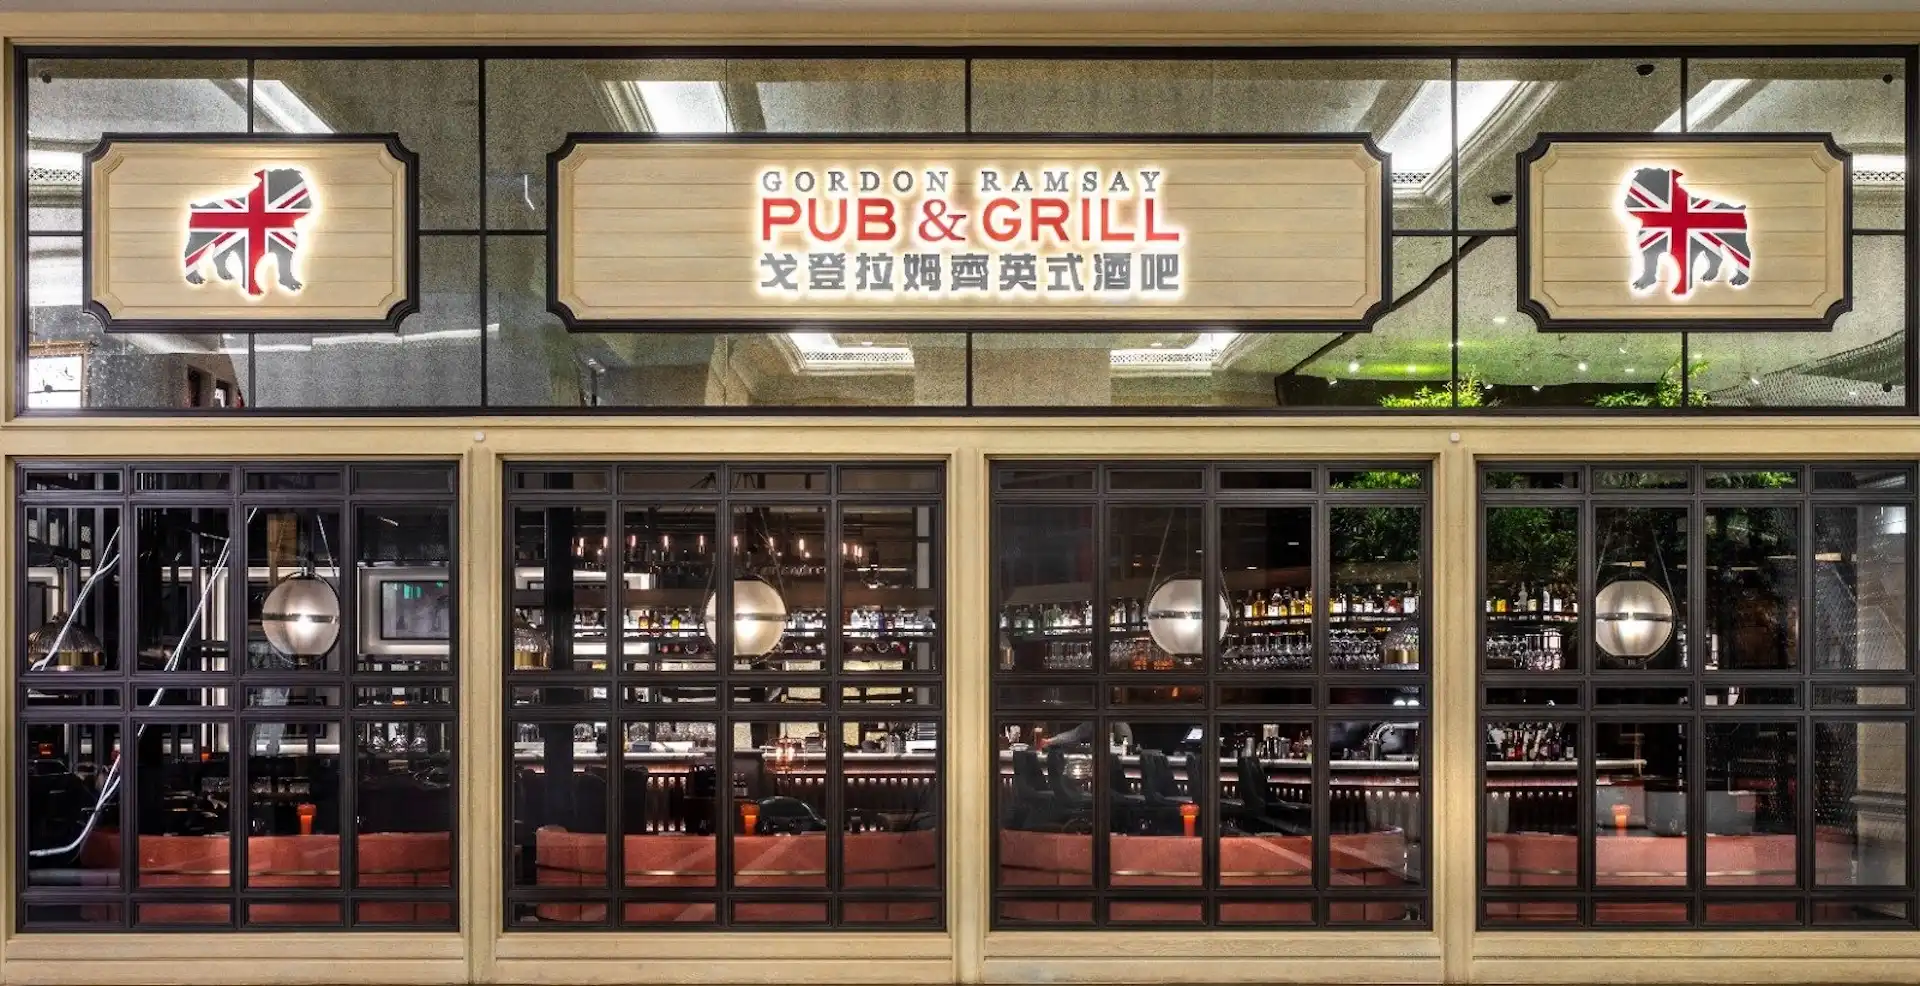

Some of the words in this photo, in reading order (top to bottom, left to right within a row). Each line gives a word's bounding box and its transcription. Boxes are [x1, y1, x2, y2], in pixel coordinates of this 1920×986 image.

[762, 171, 949, 192] GORDON
[981, 171, 1160, 192] RAMSAY
[762, 197, 896, 241] PUB
[918, 199, 967, 241] &
[982, 197, 1180, 241] GRILL
